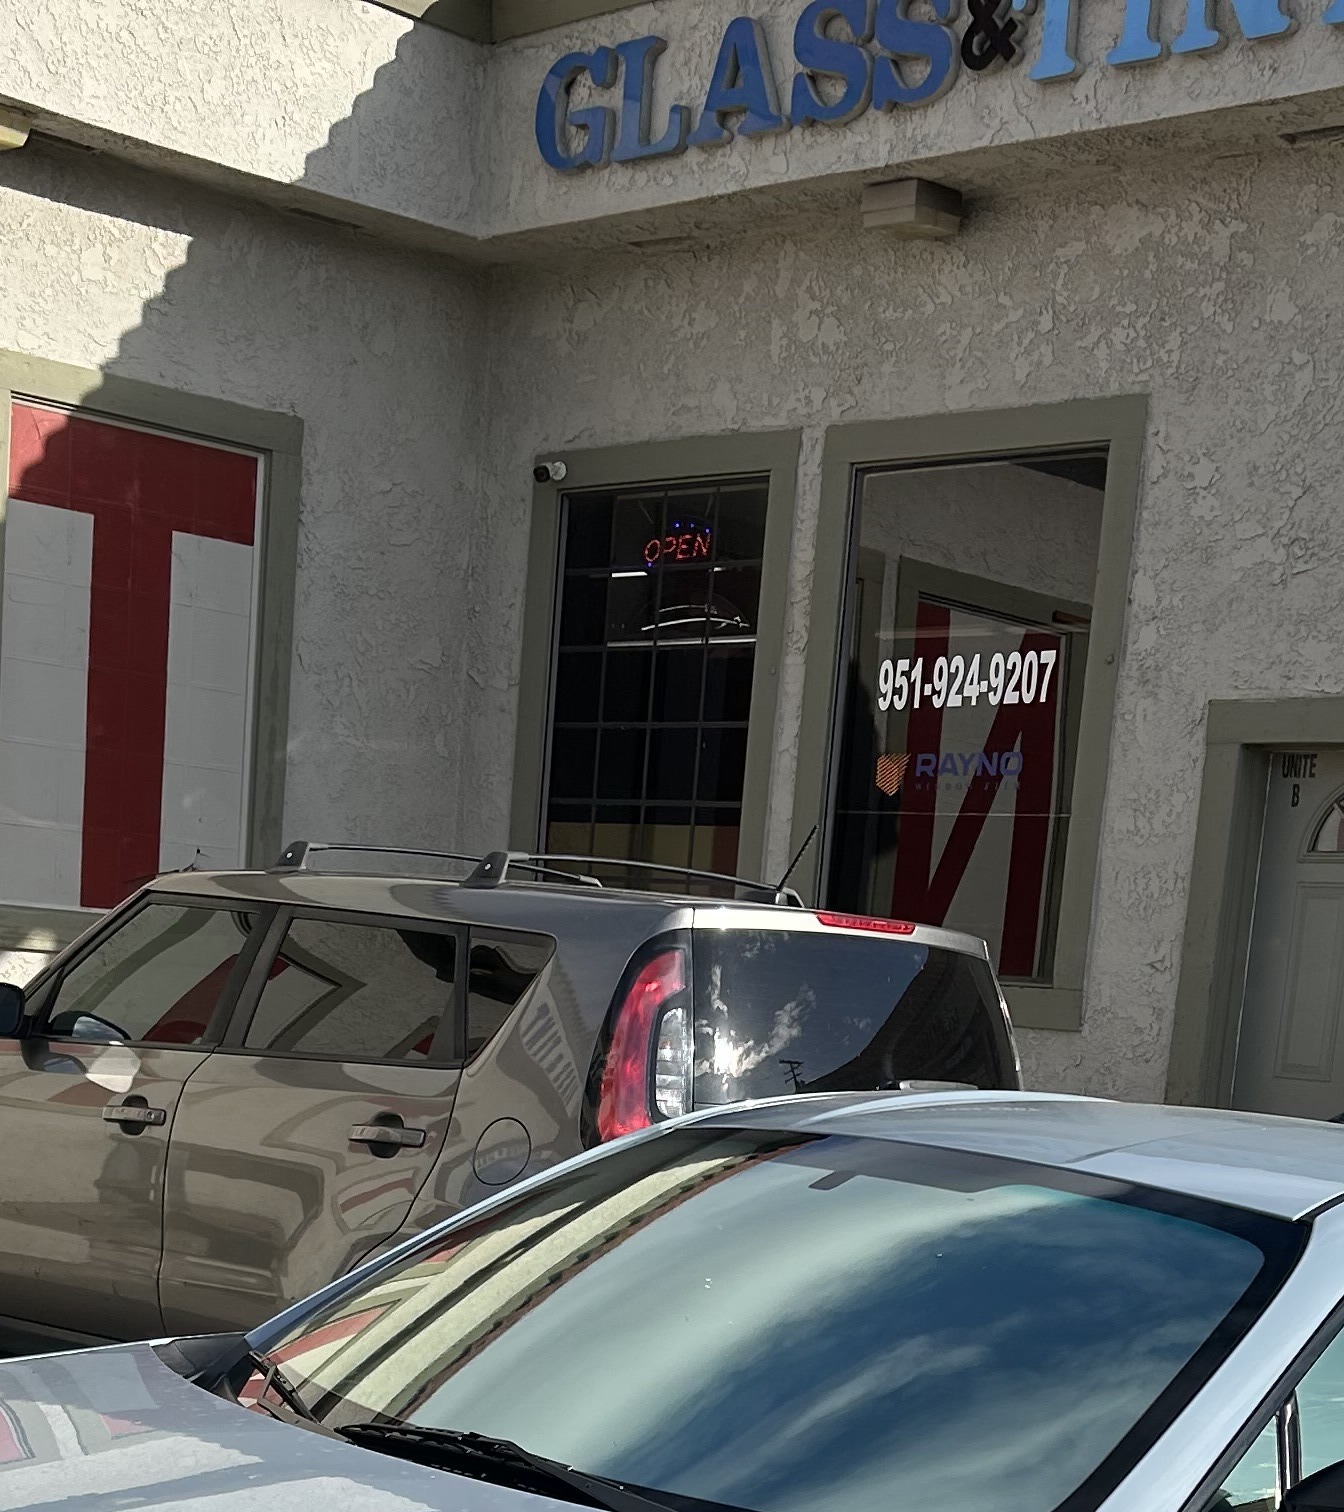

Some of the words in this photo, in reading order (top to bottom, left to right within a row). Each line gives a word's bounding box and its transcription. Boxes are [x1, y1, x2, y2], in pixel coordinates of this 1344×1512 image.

[535, 0, 960, 172] GLASS
[644, 532, 712, 564] OPEN
[877, 649, 1057, 711] 951-924-9207
[915, 750, 1024, 777] RAYNO
[1281, 753, 1318, 779] UNITE
[1291, 784, 1300, 807] B
